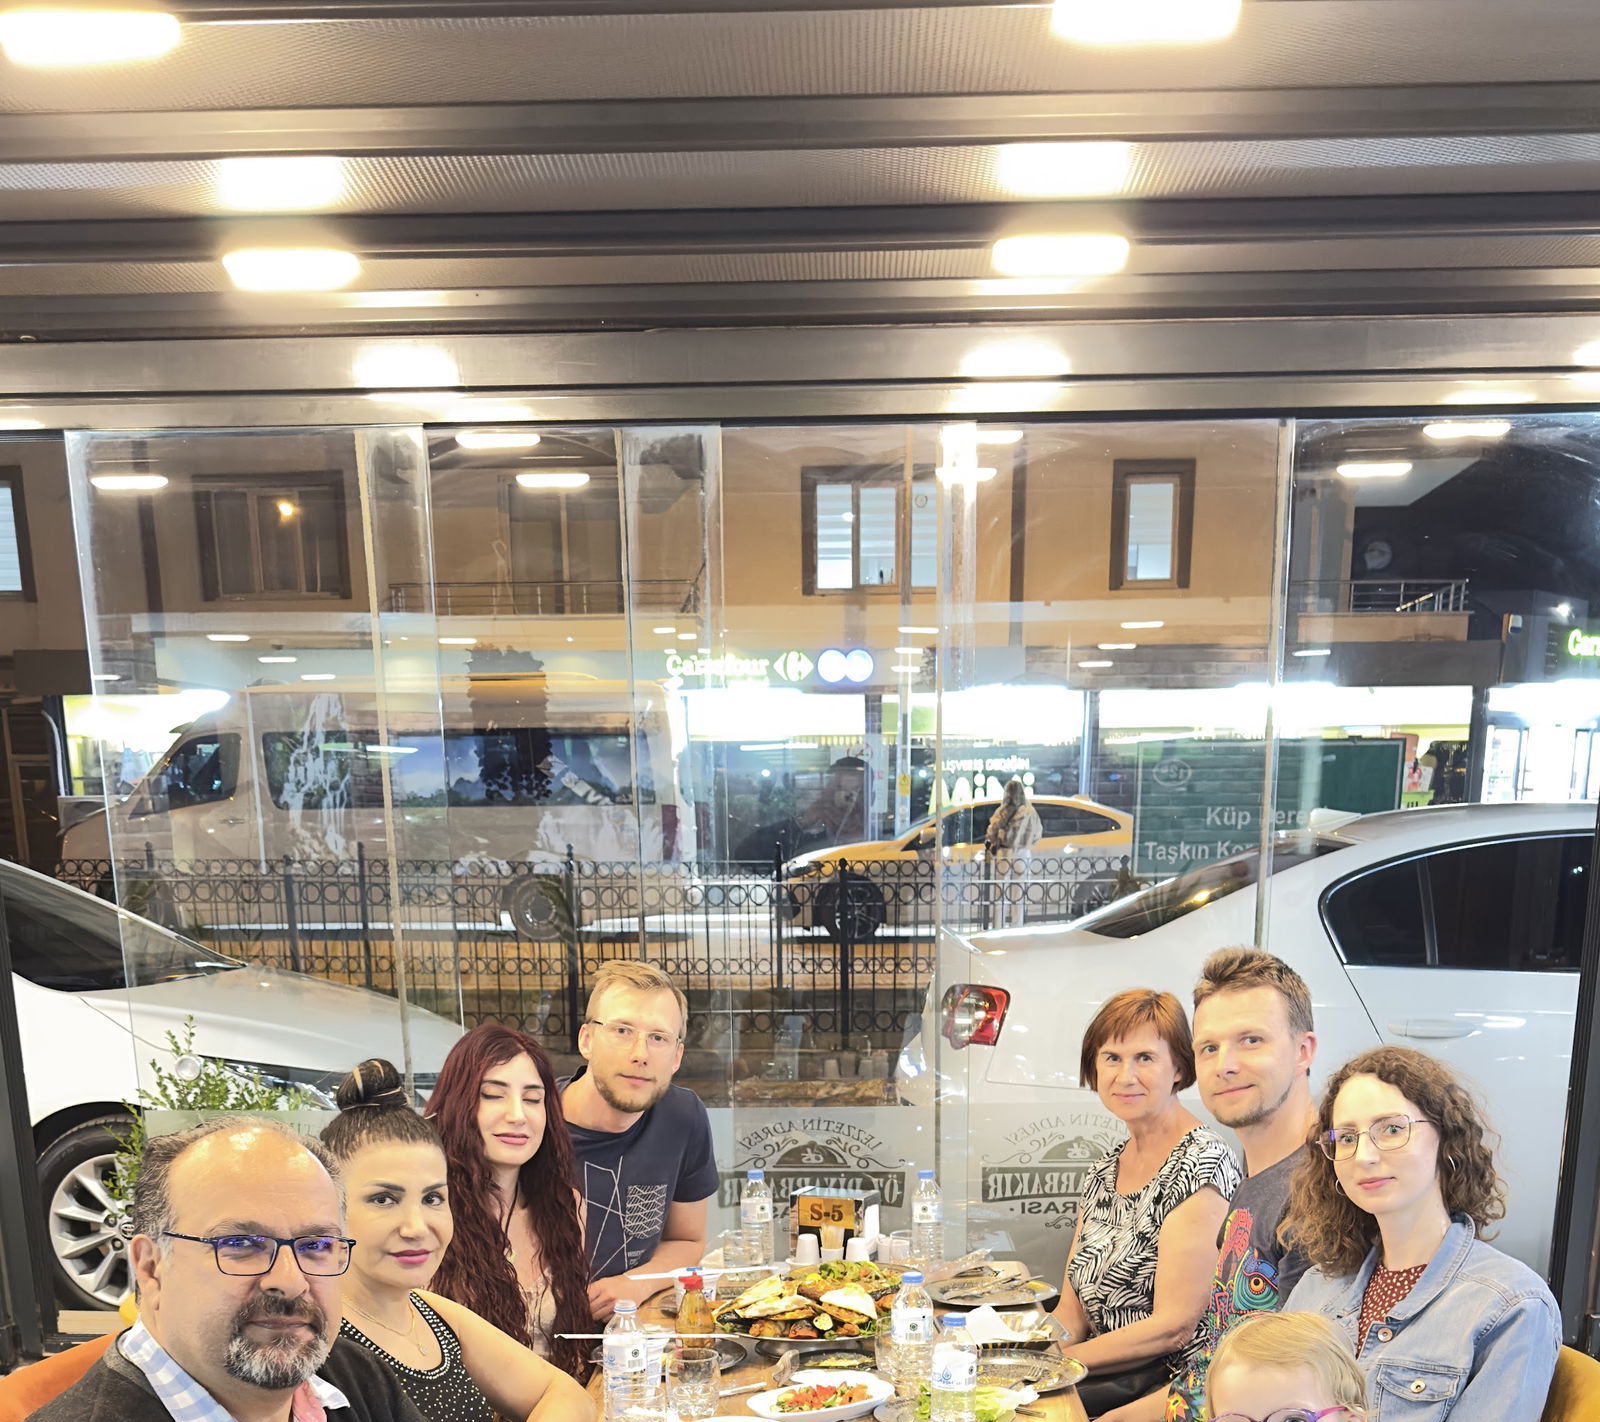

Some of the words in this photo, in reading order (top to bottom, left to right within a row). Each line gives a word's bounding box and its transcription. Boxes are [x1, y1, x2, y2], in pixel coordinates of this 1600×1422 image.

[1206, 806, 1250, 830] Küp
[1145, 841, 1209, 864] Taşkın
[810, 1203, 844, 1223] S-5
